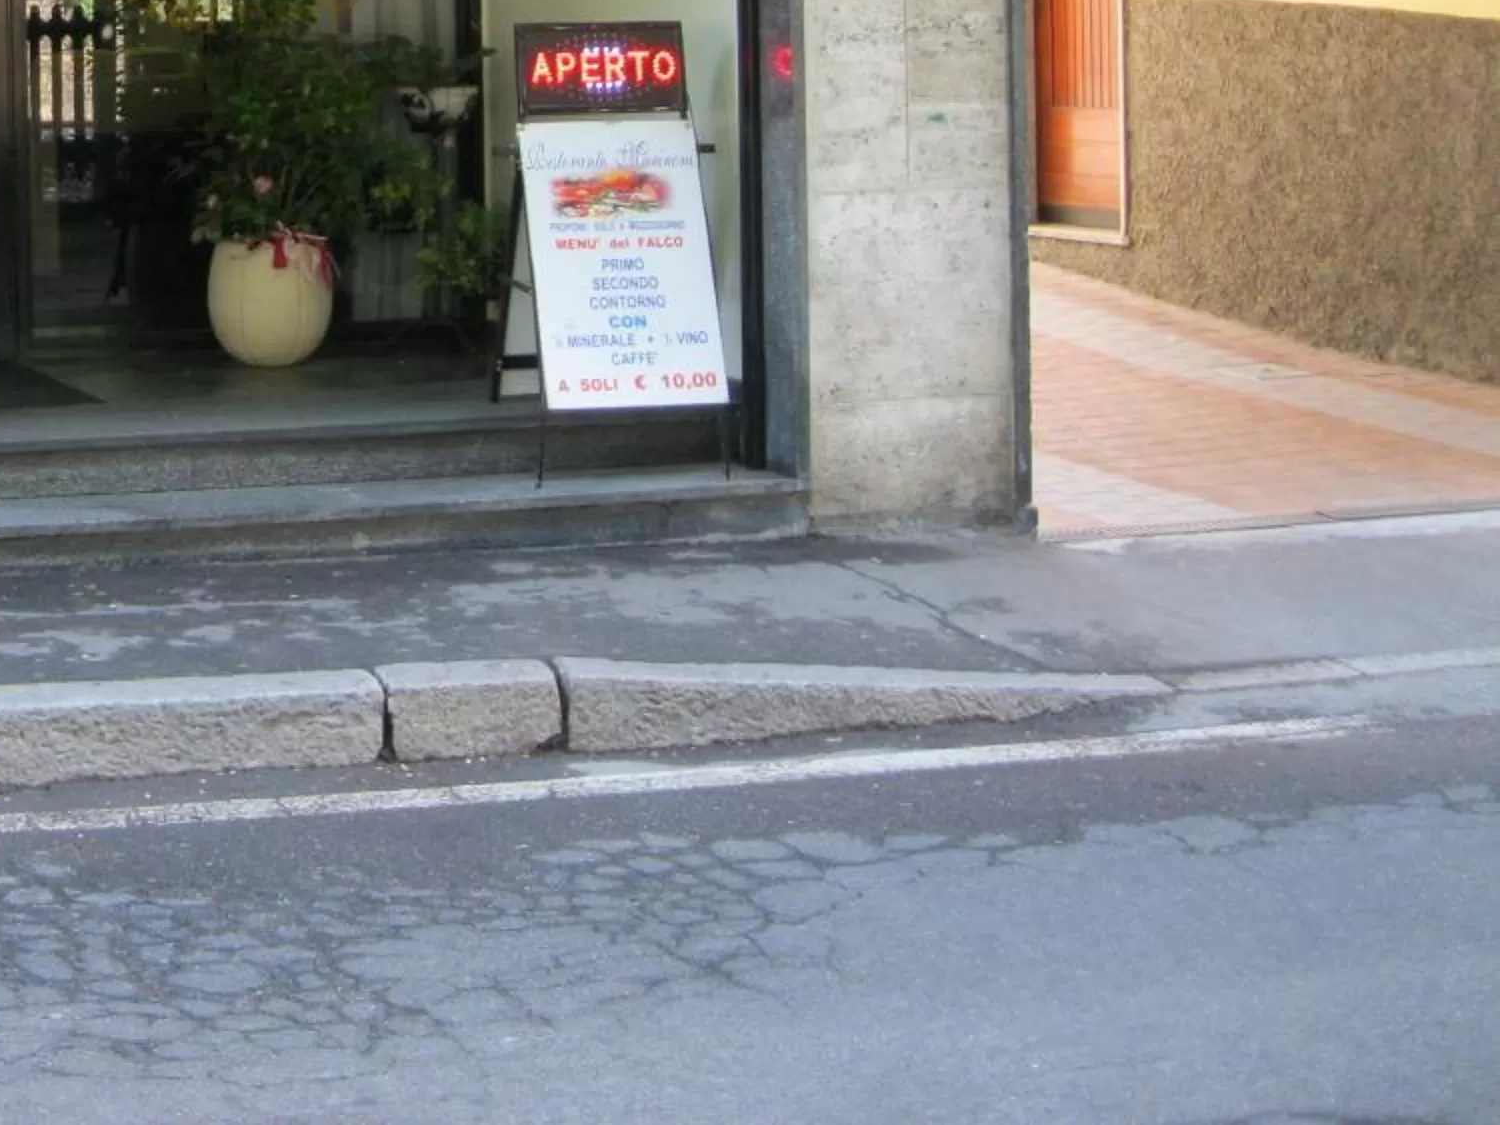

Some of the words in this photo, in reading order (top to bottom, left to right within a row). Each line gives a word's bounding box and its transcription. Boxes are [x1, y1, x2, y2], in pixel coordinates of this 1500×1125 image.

[532, 50, 677, 85] APERTO
[601, 256, 645, 272] PRIMO
[592, 275, 660, 291] SECONDO
[589, 294, 667, 310] CONTORNO
[608, 314, 648, 329] CON
[566, 332, 637, 348] MINERALE
[675, 330, 709, 346] VINO
[557, 378, 571, 393] A
[579, 377, 620, 393] SOLI
[660, 371, 719, 390] 10,00
